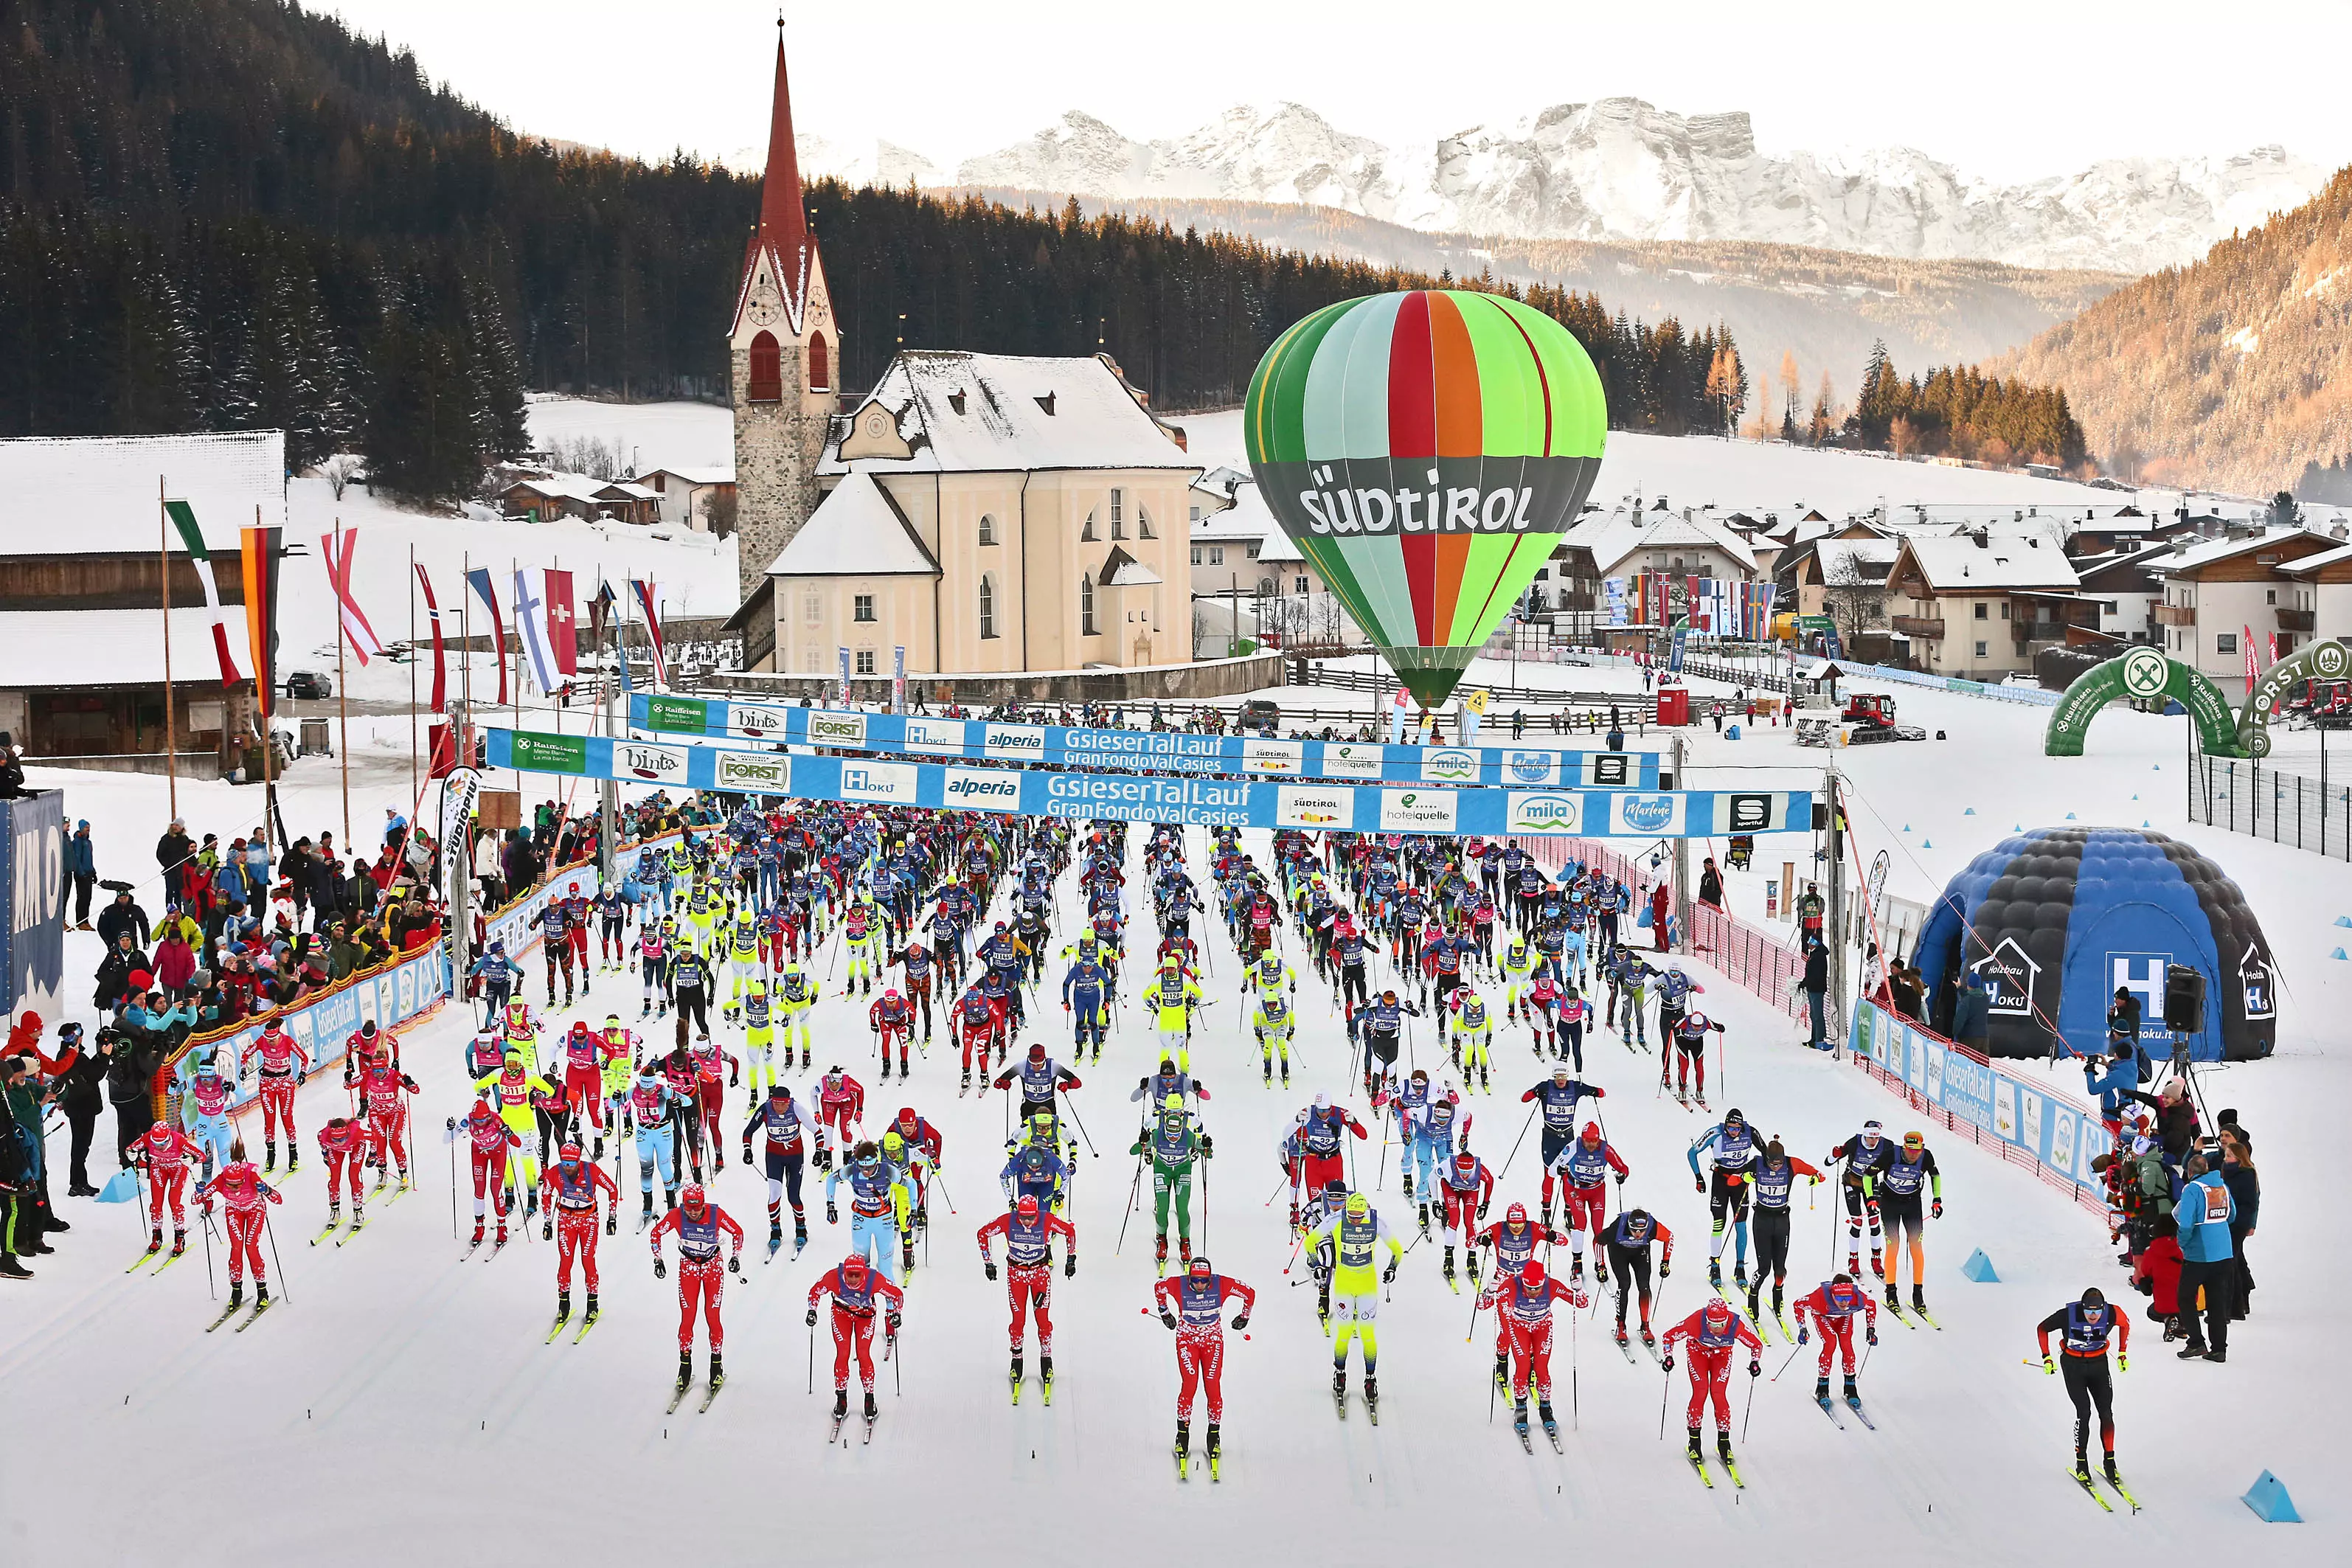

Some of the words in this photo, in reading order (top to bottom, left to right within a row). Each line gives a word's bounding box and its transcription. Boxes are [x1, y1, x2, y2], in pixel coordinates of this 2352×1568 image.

[2249, 660, 2302, 726] FORST
[2066, 687, 2092, 722] Raiffeisen
[2198, 684, 2222, 720] Raiffeisen
[665, 706, 701, 715] Raiffeisen
[816, 722, 859, 736] FORST
[533, 740, 578, 754] Raiffeisen
[988, 733, 1041, 749] alperia
[1436, 757, 1468, 769] mila
[726, 763, 782, 780] FORST
[948, 778, 1016, 797] alperia
[1387, 810, 1449, 821] hotelquelle
[1527, 802, 1567, 817] mila
[1626, 802, 1670, 821] Marlene
[1988, 965, 2024, 975] Holzbau
[2114, 958, 2164, 1018] H
[1033, 1085, 1042, 1093] 30
[282, 1089, 291, 1116] Internorm
[1556, 1106, 1566, 1114] 34
[1551, 1116, 1569, 1124] alperia
[775, 1134, 794, 1142] alperia
[1732, 1151, 1741, 1159] 26
[1726, 1159, 1745, 1168] alperia
[1580, 1173, 1600, 1182] alperia
[1768, 1186, 1777, 1194] 17
[1762, 1197, 1782, 1205] alperia
[228, 1214, 243, 1241] TRENTINO
[246, 1211, 263, 1246] Internorm
[558, 1229, 571, 1257] TRENTINO
[581, 1224, 596, 1257] Internorm
[1356, 1245, 1361, 1254] 5
[1510, 1252, 1520, 1260] 15
[1179, 1346, 1196, 1376] TRENTINO
[1206, 1342, 1221, 1380] Internorm
